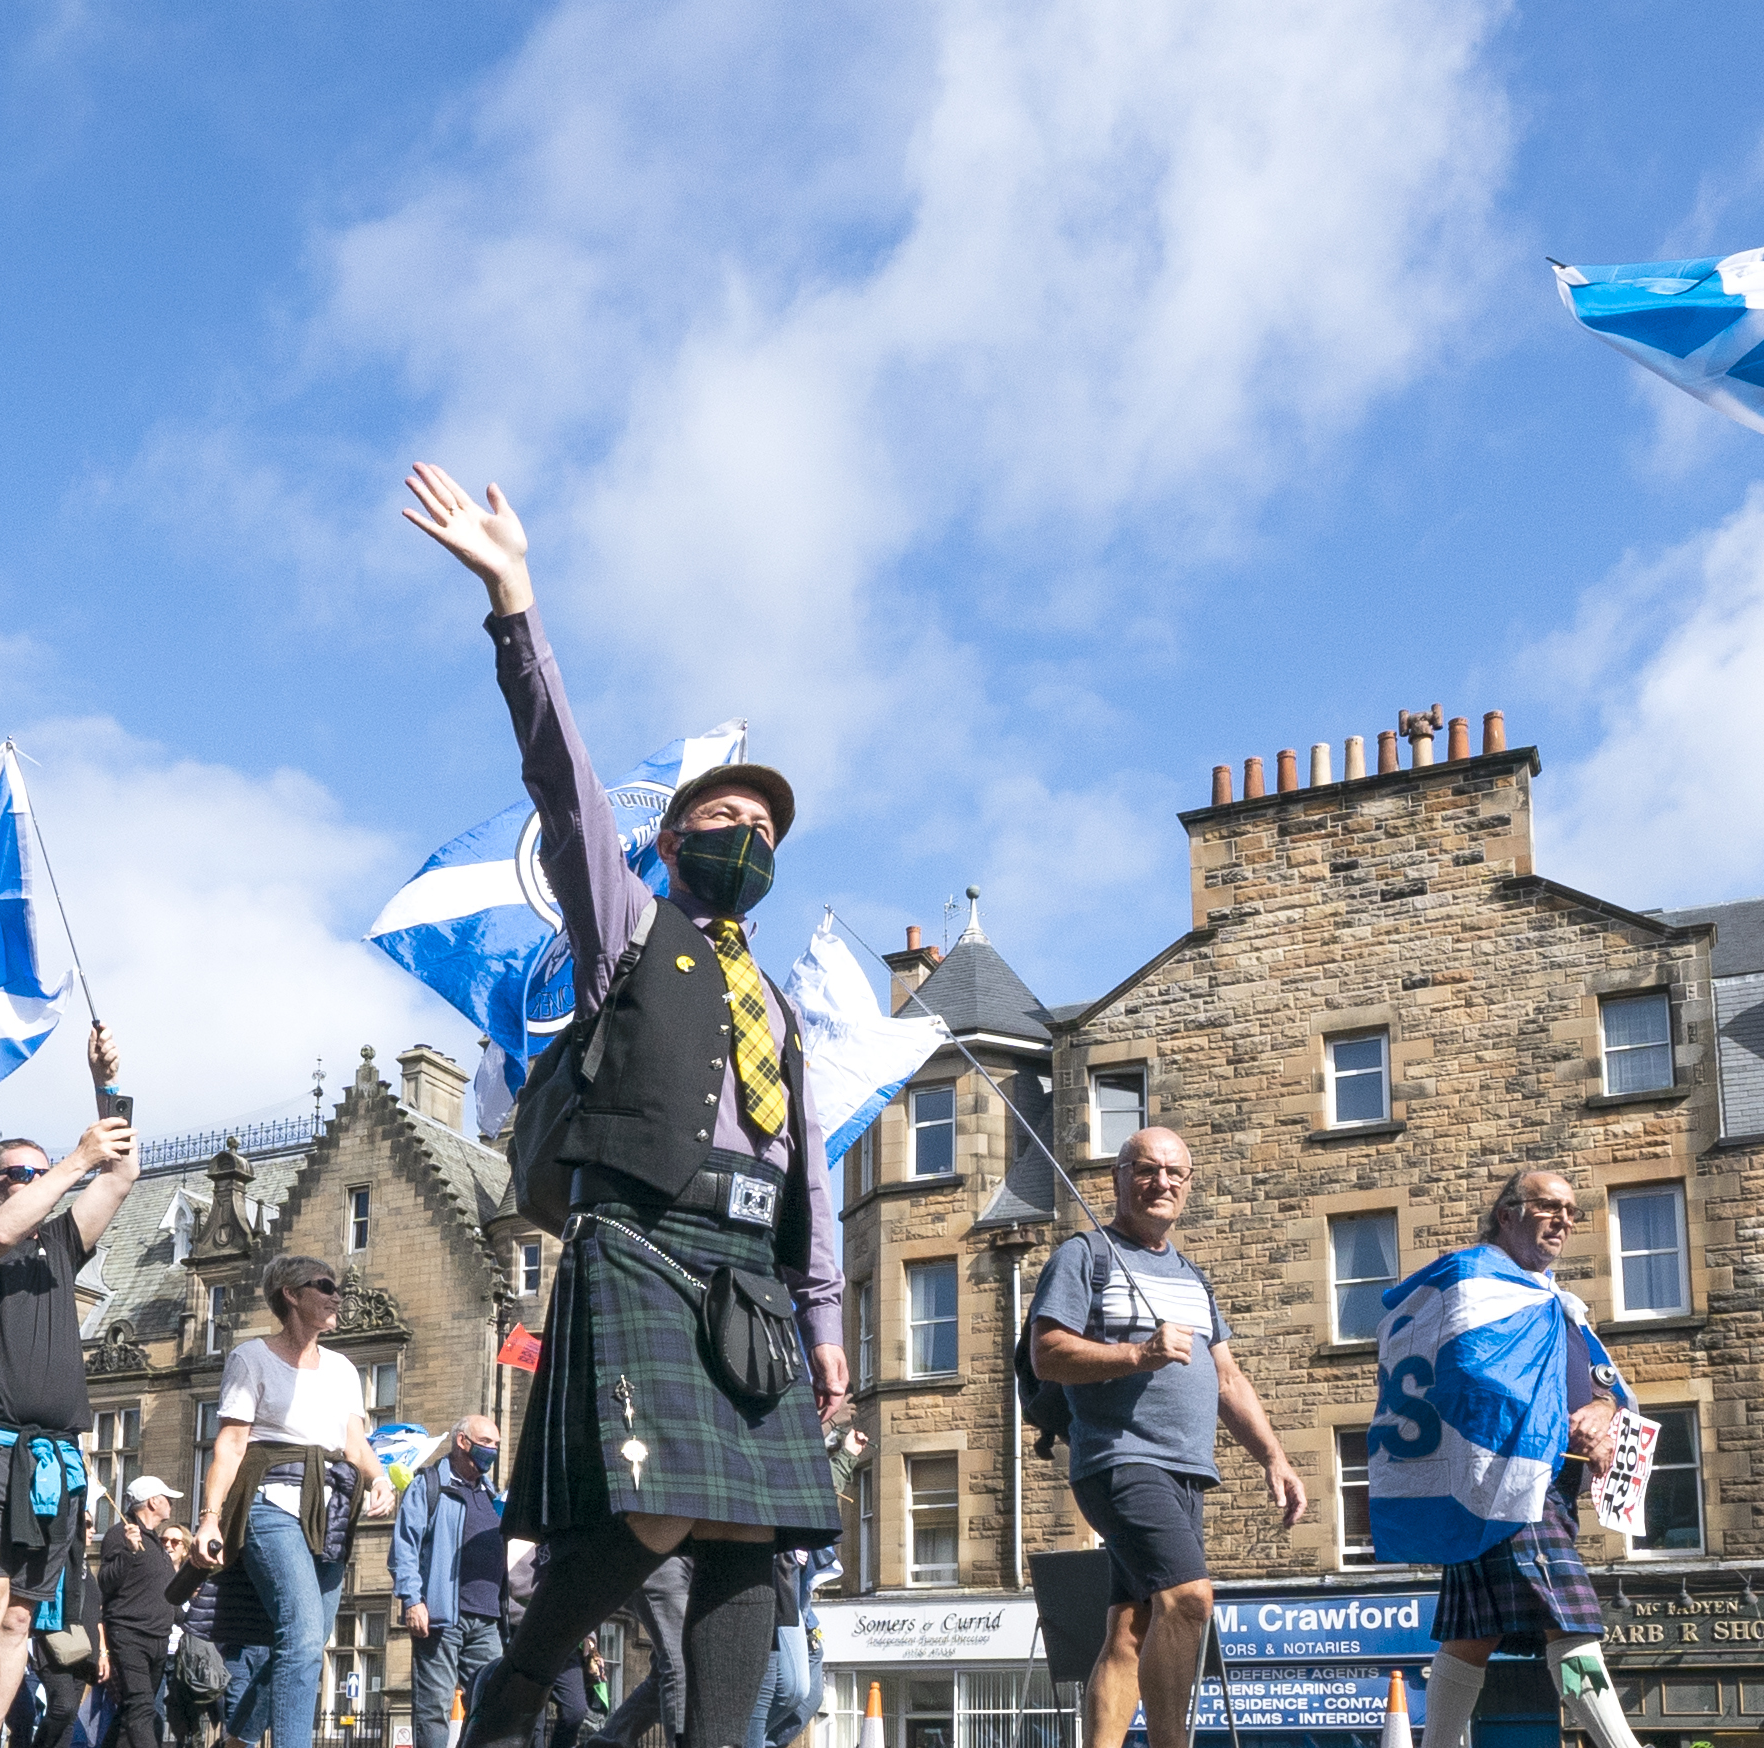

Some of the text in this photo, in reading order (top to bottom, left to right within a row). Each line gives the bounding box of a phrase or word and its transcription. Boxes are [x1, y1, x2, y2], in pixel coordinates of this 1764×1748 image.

[1601, 1416, 1631, 1516] RULE
[1612, 1422, 1641, 1523] TORY
[1623, 1425, 1656, 1525] DEFY
[854, 1614, 916, 1635] Somers
[942, 1608, 1006, 1631] Currid
[1257, 1599, 1420, 1632] Crawford
[1220, 1640, 1361, 1656] ORS & NOTARIES
[1230, 1667, 1309, 1681] DEFENCE
[1312, 1666, 1380, 1680] AGENTS
[1270, 1682, 1357, 1696] HEARINGS
[1213, 1697, 1308, 1711] RESIDENCE
[1220, 1712, 1283, 1725] CLAIMS
